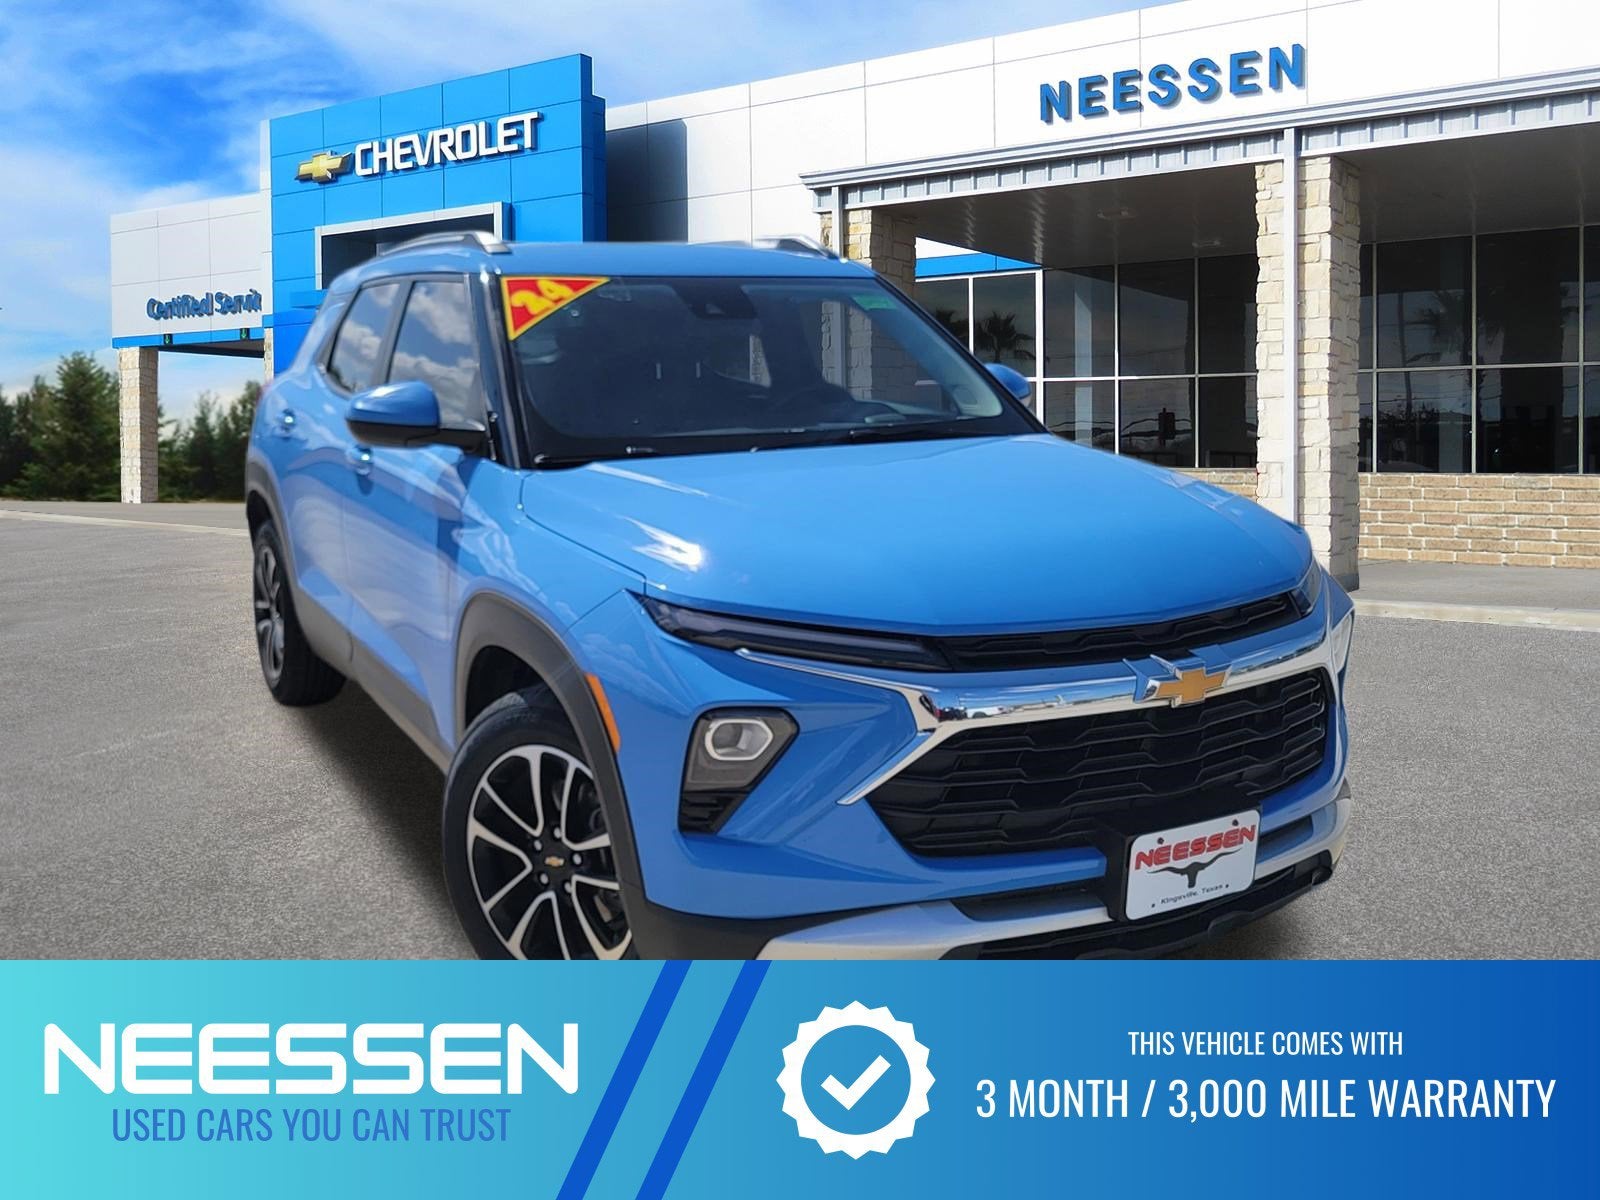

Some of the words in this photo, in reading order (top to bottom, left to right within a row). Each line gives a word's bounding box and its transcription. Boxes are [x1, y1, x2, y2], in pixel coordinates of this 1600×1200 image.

[1040, 44, 1304, 124] NEESSEN
[354, 111, 541, 177] CHEVROLET
[147, 292, 213, 320] Certified
[1135, 825, 1256, 870] NEESSEN
[1202, 884, 1223, 894] Texas
